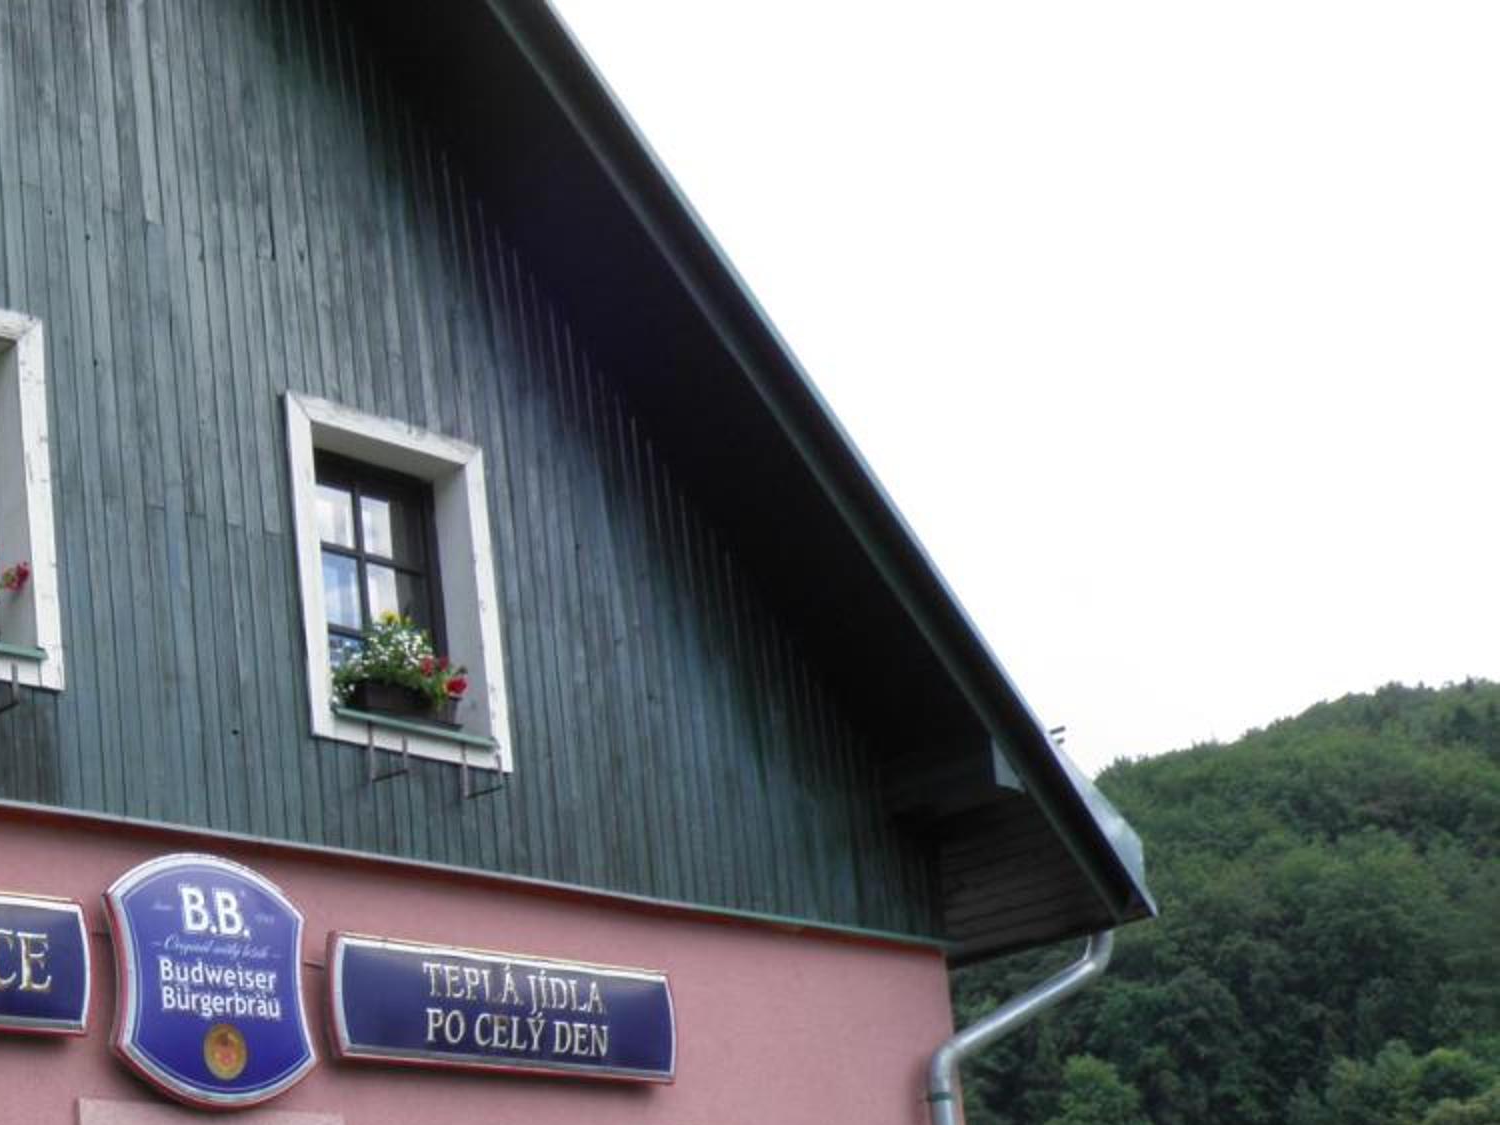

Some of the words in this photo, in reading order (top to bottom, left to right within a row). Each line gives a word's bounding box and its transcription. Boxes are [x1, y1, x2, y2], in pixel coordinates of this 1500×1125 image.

[158, 955, 277, 990] Budweiser
[422, 961, 522, 1006] TEPLÁ
[529, 969, 605, 1015] JÍDLA
[161, 986, 281, 1019] Bürgerbräu
[426, 1008, 465, 1045] PO
[474, 1007, 546, 1052] CELÝ
[553, 1022, 610, 1058] DEN
